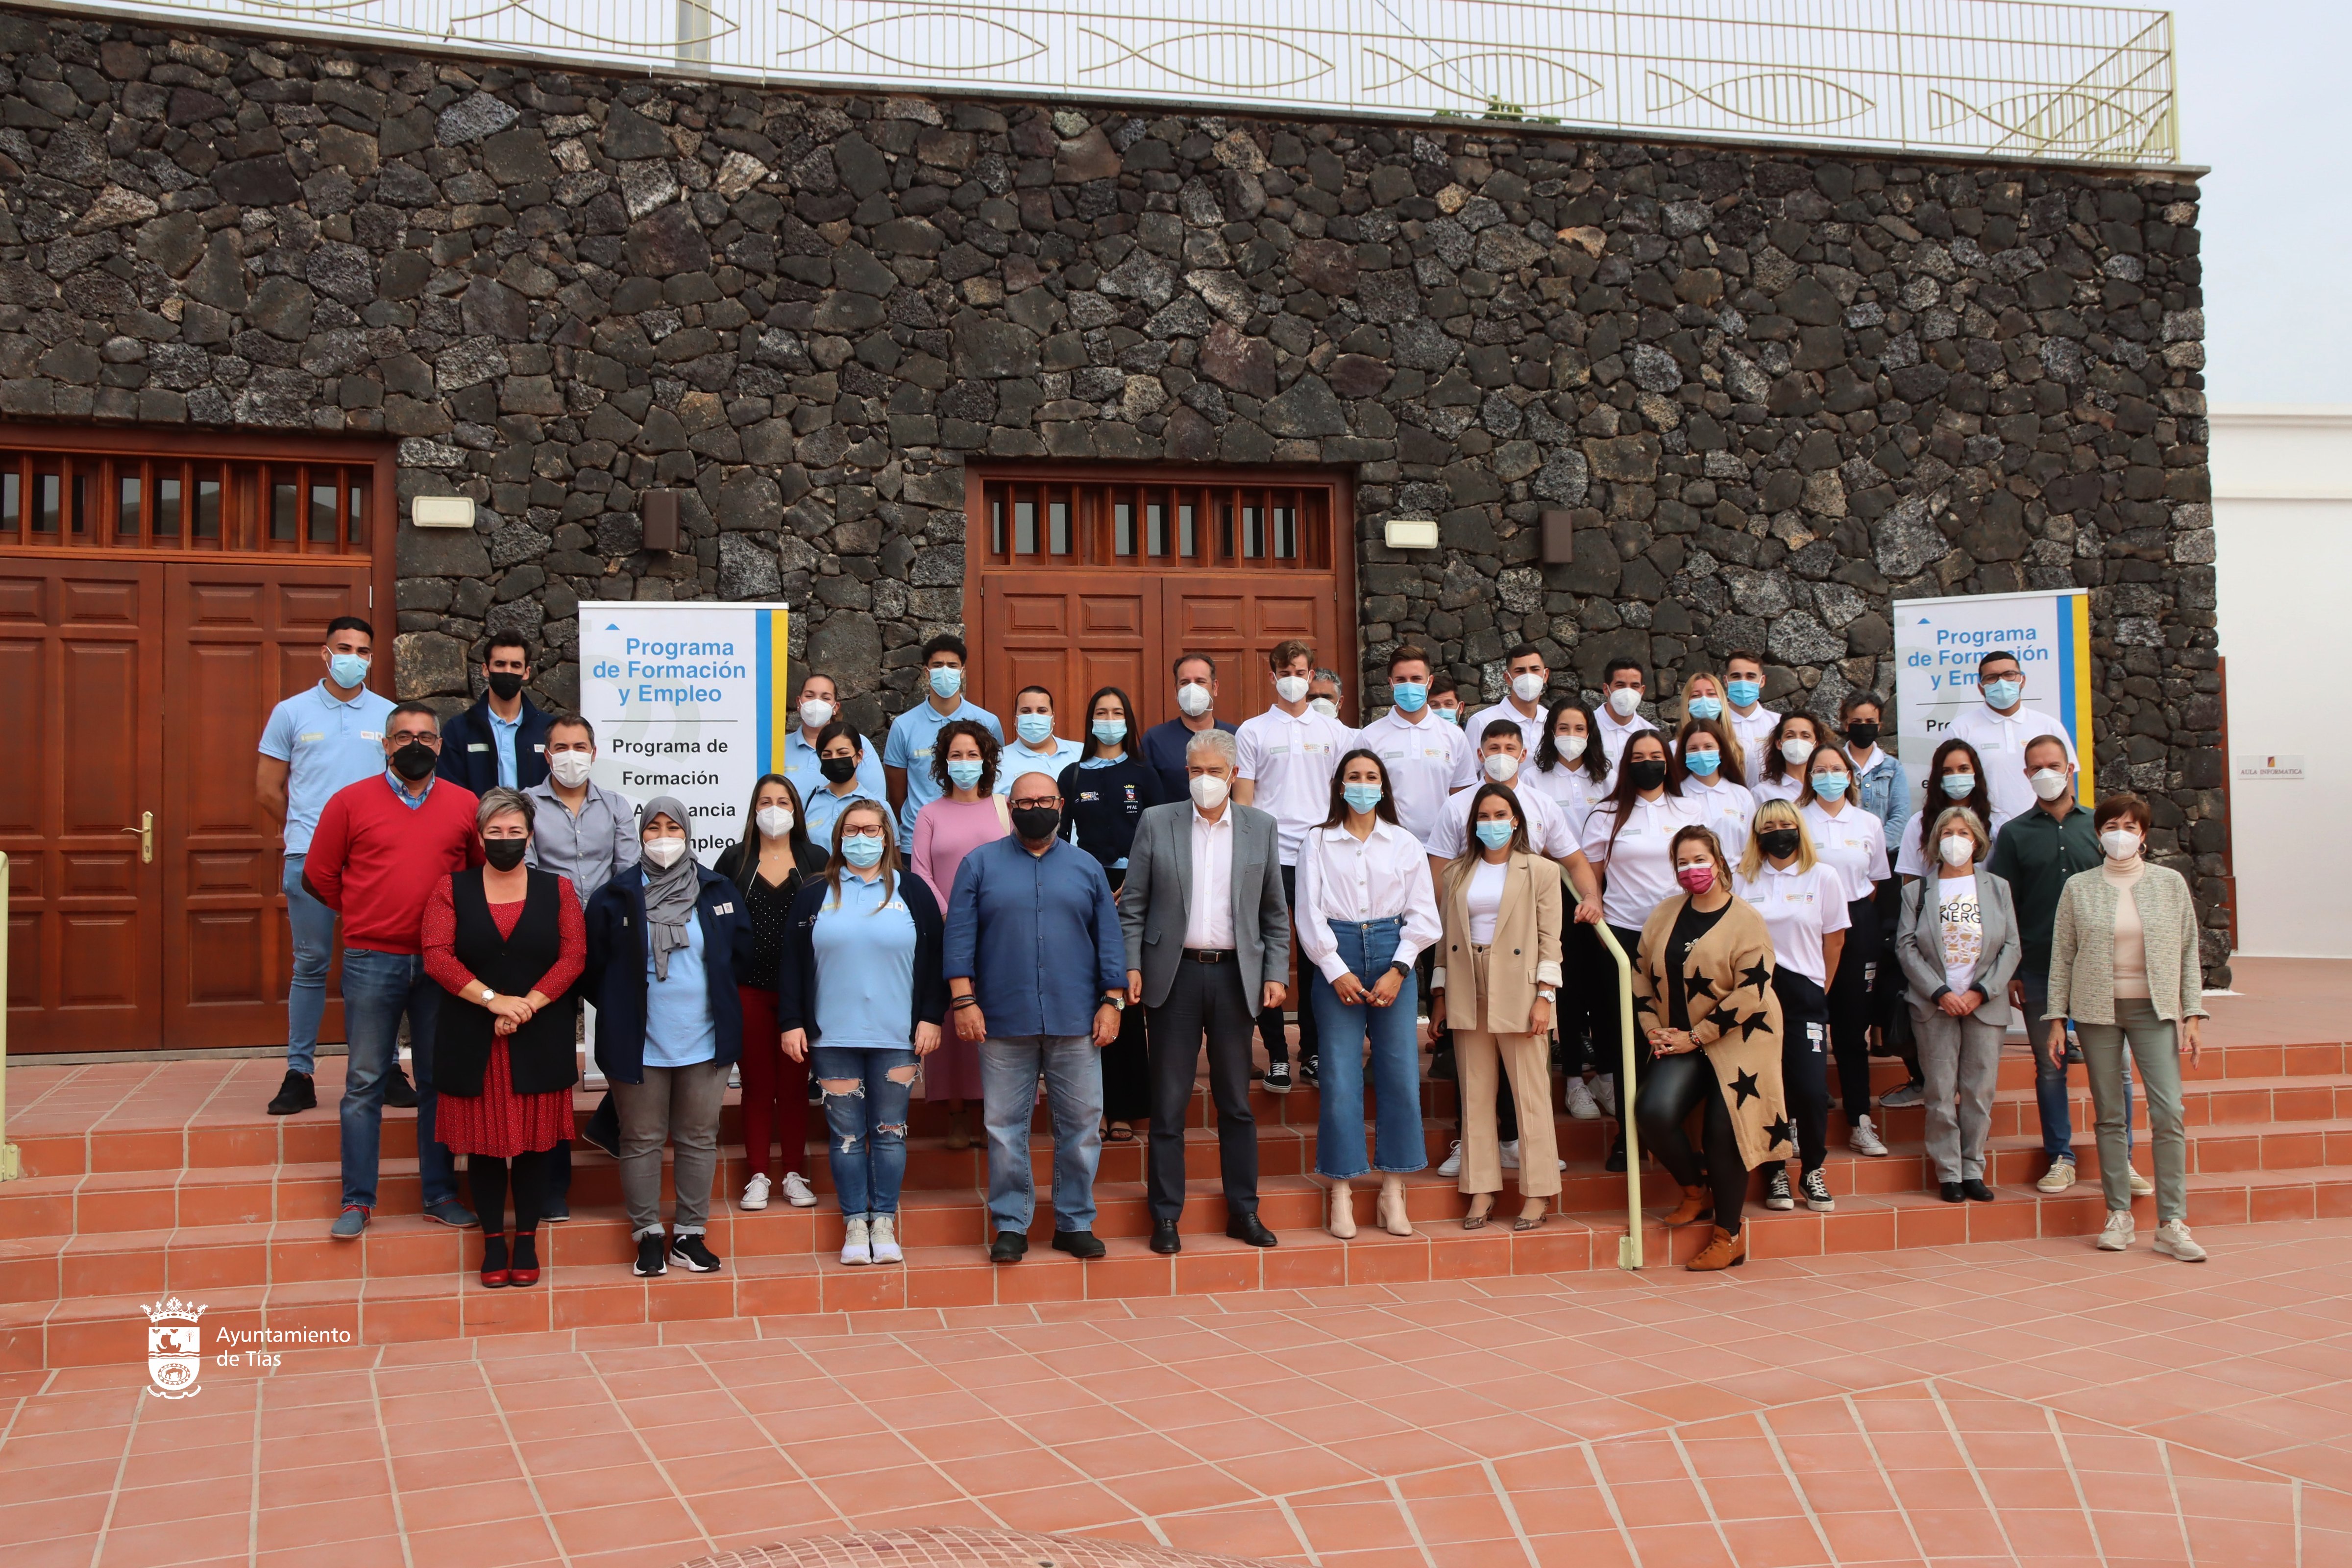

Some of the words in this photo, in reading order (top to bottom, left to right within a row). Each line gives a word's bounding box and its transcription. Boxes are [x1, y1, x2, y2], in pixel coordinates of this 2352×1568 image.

[1937, 628, 2037, 647] Programa
[627, 638, 734, 660] Programa
[1908, 652, 1932, 667] de
[1939, 644, 2049, 665] Formión
[593, 662, 620, 678] de
[628, 661, 746, 679] Formación
[1930, 674, 1942, 690] y
[618, 688, 631, 706] y
[638, 685, 722, 706] Empleo
[612, 739, 701, 757] Programa
[707, 739, 728, 753] de
[623, 771, 718, 785] Formación
[1940, 911, 1981, 924] NERG
